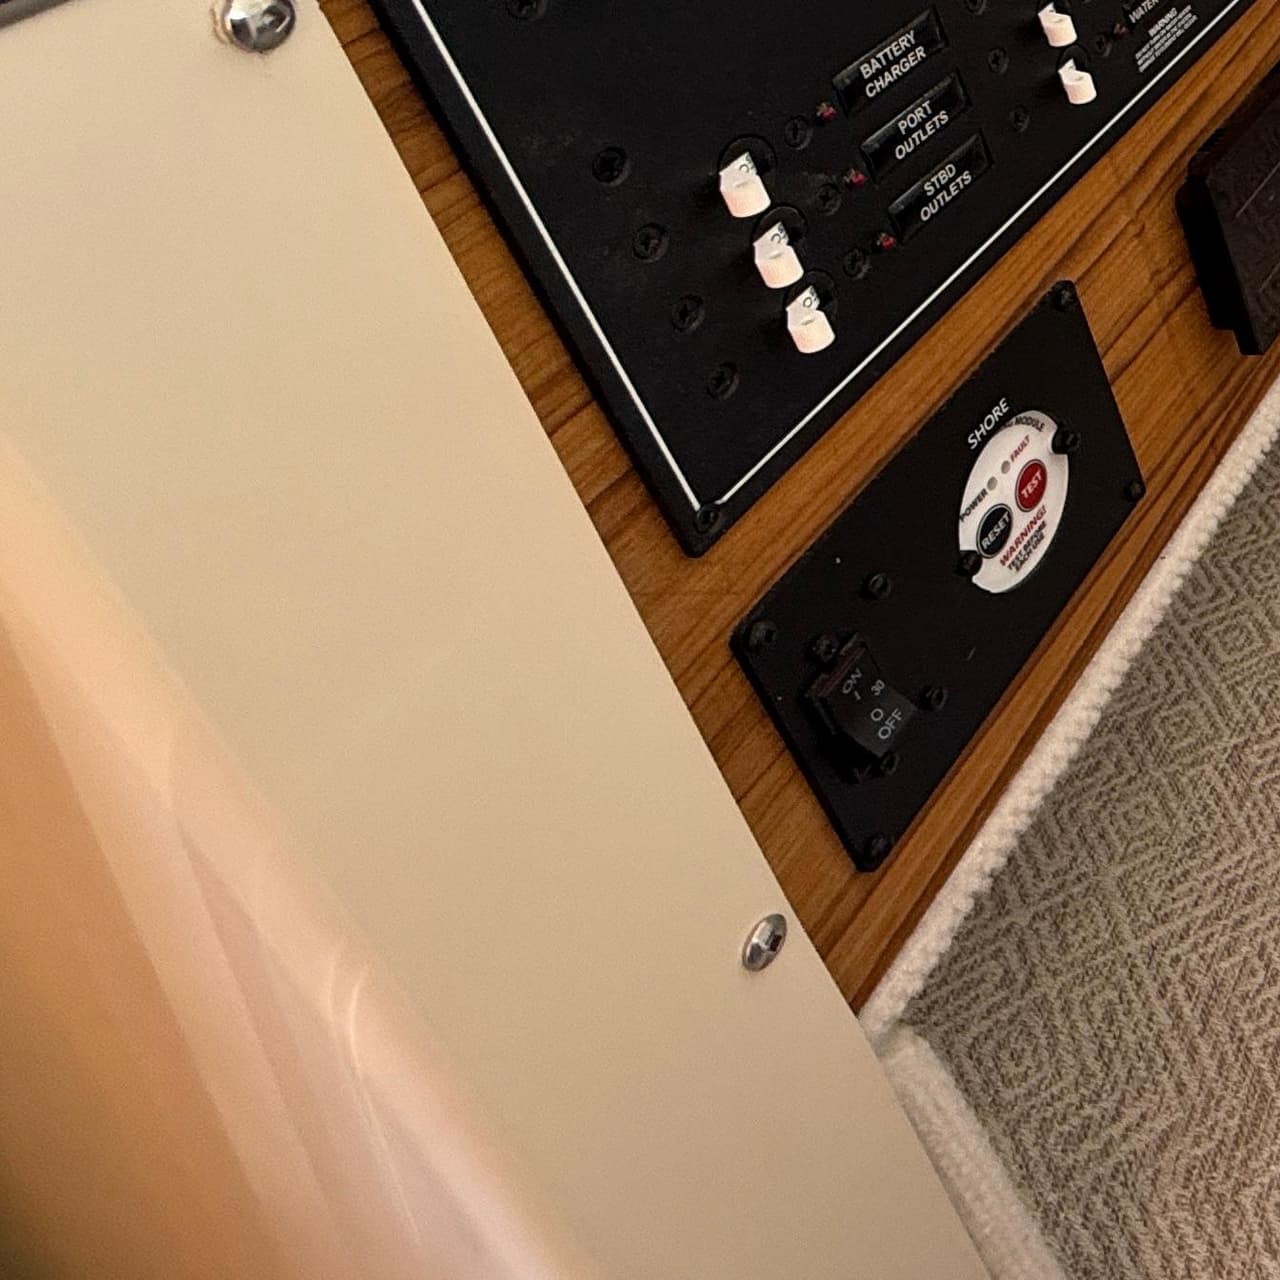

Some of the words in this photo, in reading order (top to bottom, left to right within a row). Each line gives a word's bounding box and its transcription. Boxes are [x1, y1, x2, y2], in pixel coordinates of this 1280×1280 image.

[859, 29, 917, 79] BATTERY
[865, 45, 927, 99] CHARGER
[894, 110, 950, 161] OUTLETS
[897, 100, 933, 135] PORT
[919, 171, 973, 222] OUTLETS
[923, 163, 957, 197] STBD
[967, 396, 1011, 451] SHORE
[1010, 434, 1031, 463] FAULT
[1020, 470, 1042, 500] TEST
[959, 487, 989, 523] POWER
[981, 510, 1011, 551] RESET
[841, 667, 863, 695] ON
[878, 708, 903, 740] OFF
